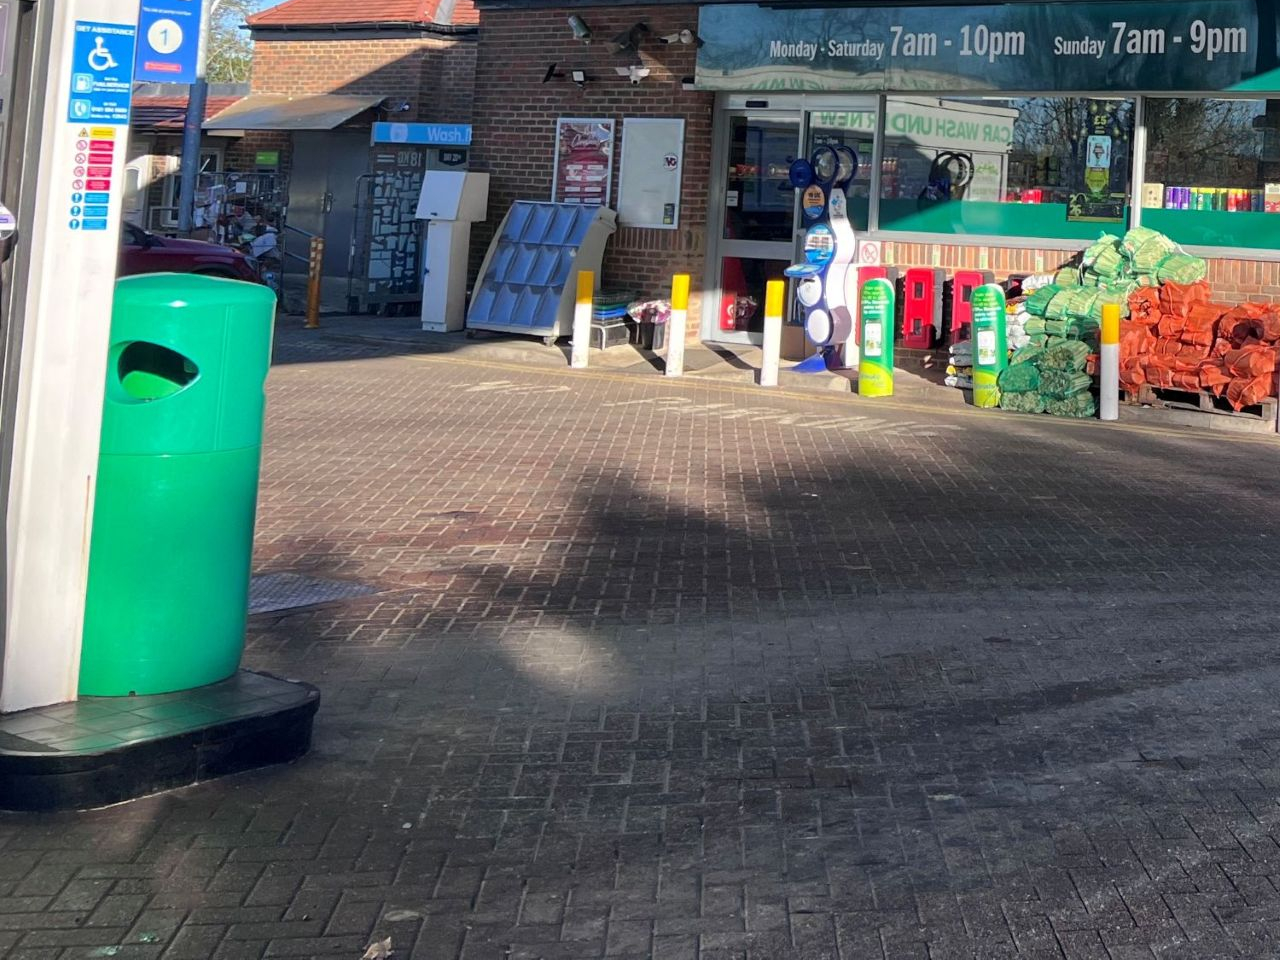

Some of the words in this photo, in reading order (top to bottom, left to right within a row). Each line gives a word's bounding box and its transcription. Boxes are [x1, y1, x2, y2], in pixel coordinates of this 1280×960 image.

[159, 28, 169, 47] 1
[769, 40, 817, 61] Monday
[828, 40, 885, 61] Saturday
[889, 26, 937, 56] 7am
[959, 24, 1025, 63] 10pm
[1054, 36, 1106, 59] Sunday
[1111, 21, 1165, 54] 7am
[1190, 19, 1247, 61] 9pm
[1093, 116, 1107, 125] £5
